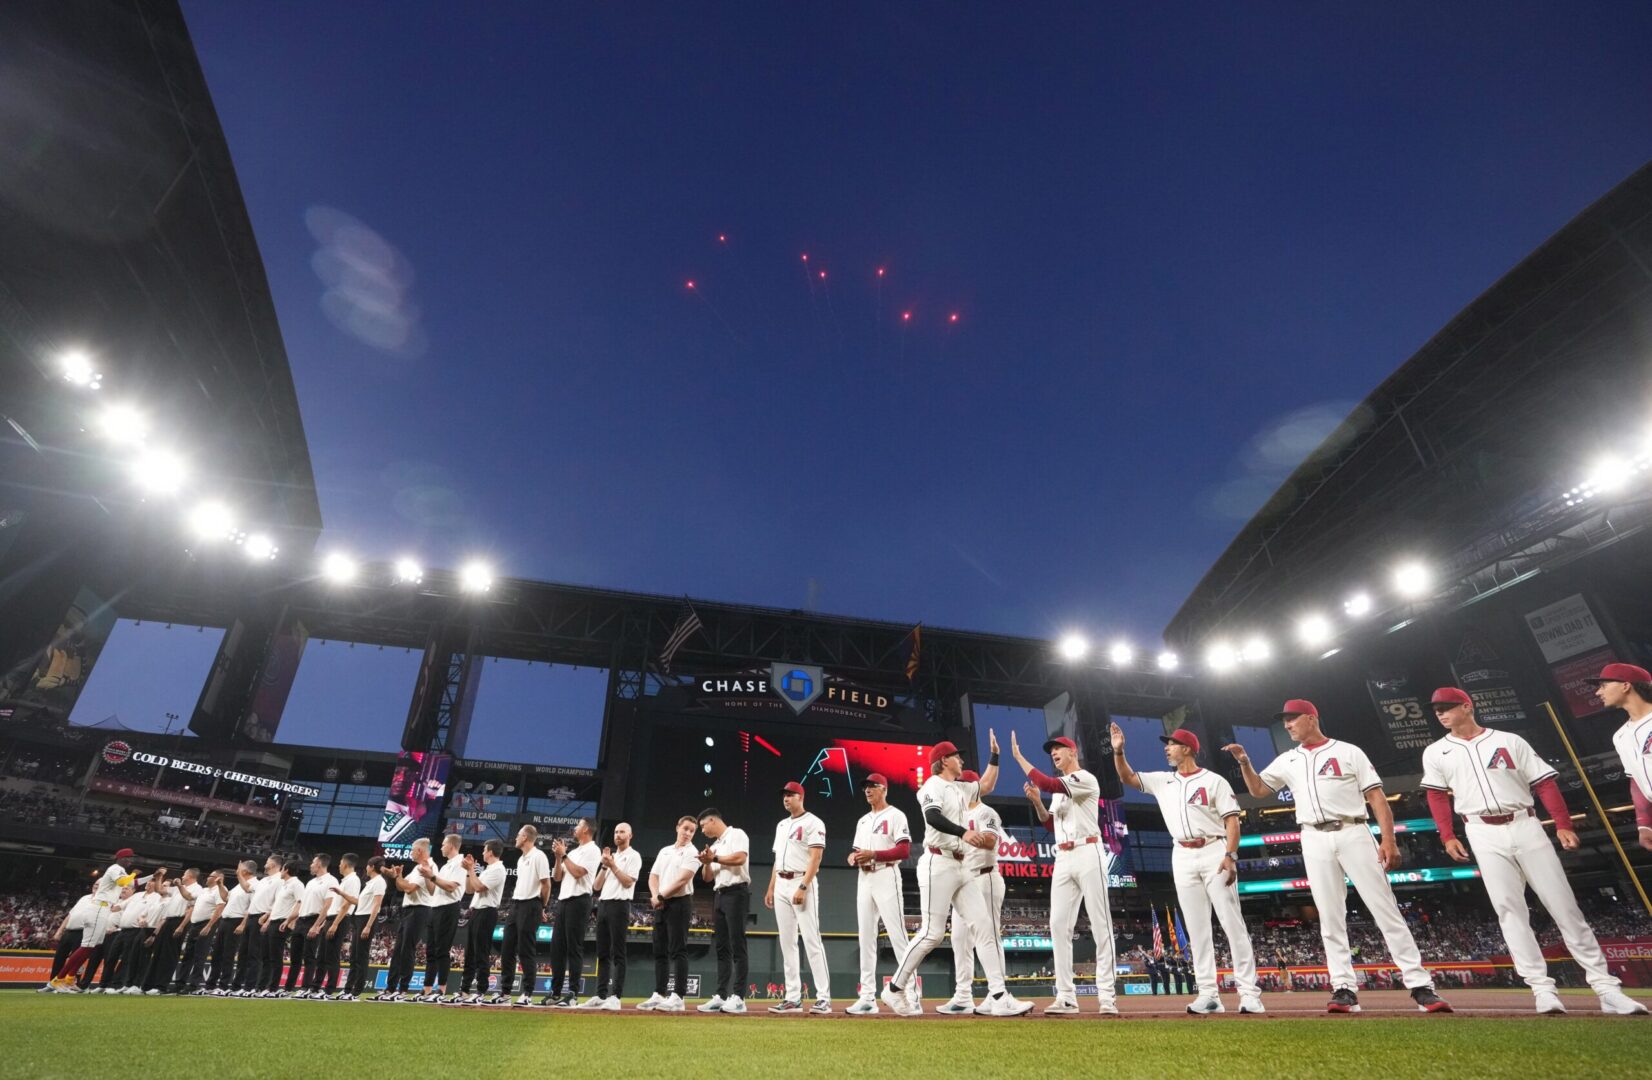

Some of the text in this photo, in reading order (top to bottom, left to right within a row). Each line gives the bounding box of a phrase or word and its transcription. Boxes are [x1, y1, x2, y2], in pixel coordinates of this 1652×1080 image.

[702, 680, 888, 709] CHASE FIELD
[1471, 688, 1516, 701] STREAM
[1475, 699, 1493, 708] ANY
[811, 705, 867, 719] DIAMONDBACKS
[1382, 701, 1424, 720] $93
[1388, 719, 1428, 729] MILLION
[465, 760, 482, 768] WEST
[484, 762, 522, 771] CHAMPIONS
[132, 751, 168, 766] COLD
[170, 759, 213, 776] BEERS
[213, 768, 222, 778] &
[223, 770, 320, 798] CHEESEBURGERS
[535, 766, 594, 777] WORLD CHAMPIONS
[1277, 790, 1293, 802] 42
[459, 811, 497, 820] WILD CARD
[533, 815, 581, 825] NL CHAMPION
[997, 838, 1038, 858] oors
[1003, 938, 1051, 948] PERDOM
